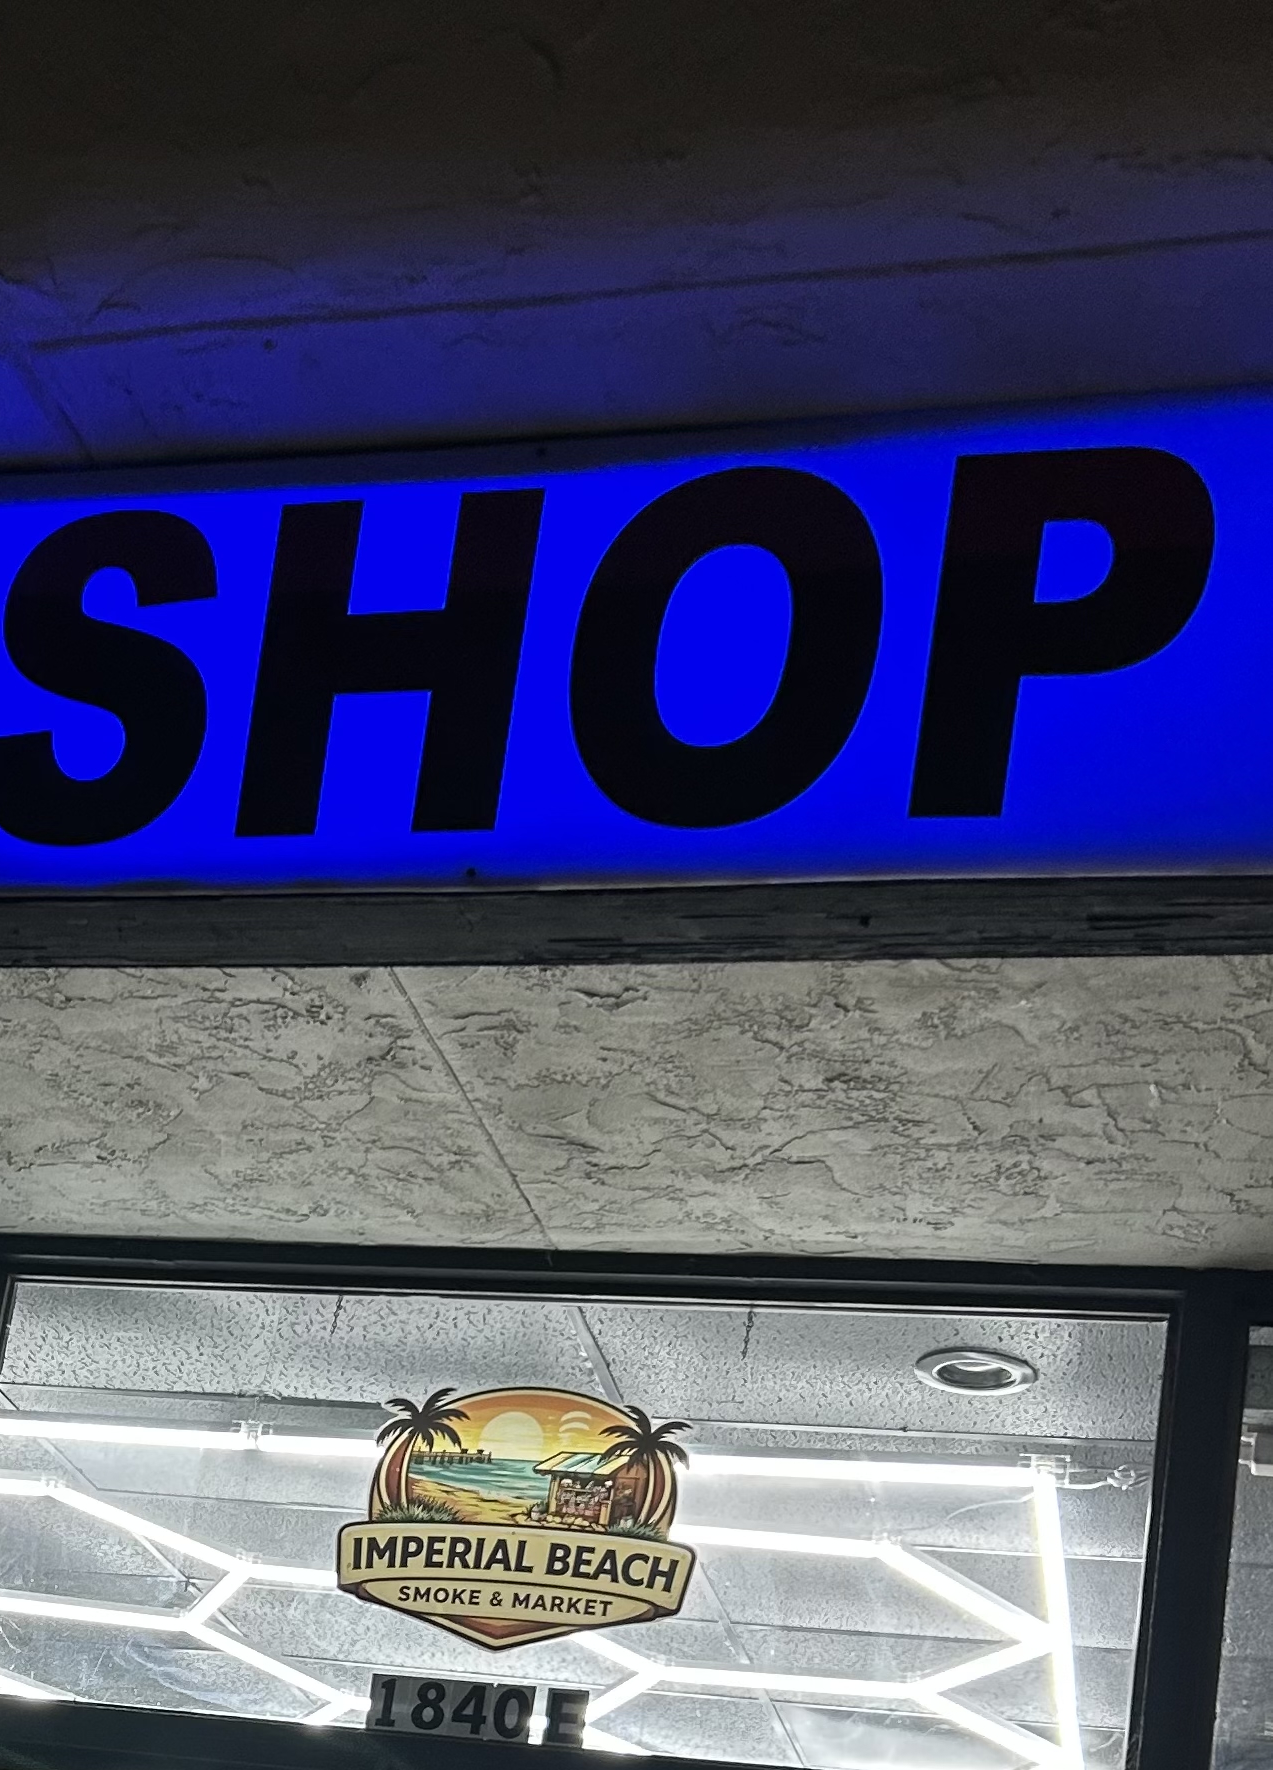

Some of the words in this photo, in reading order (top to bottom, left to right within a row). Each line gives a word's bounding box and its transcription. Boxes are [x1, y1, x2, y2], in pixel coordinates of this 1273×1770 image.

[351, 1535, 534, 1574] IMPERIAL
[544, 1542, 680, 1594] BEACH
[397, 1585, 482, 1608] SMOKE
[490, 1590, 503, 1608] &
[511, 1591, 614, 1619] MARKET
